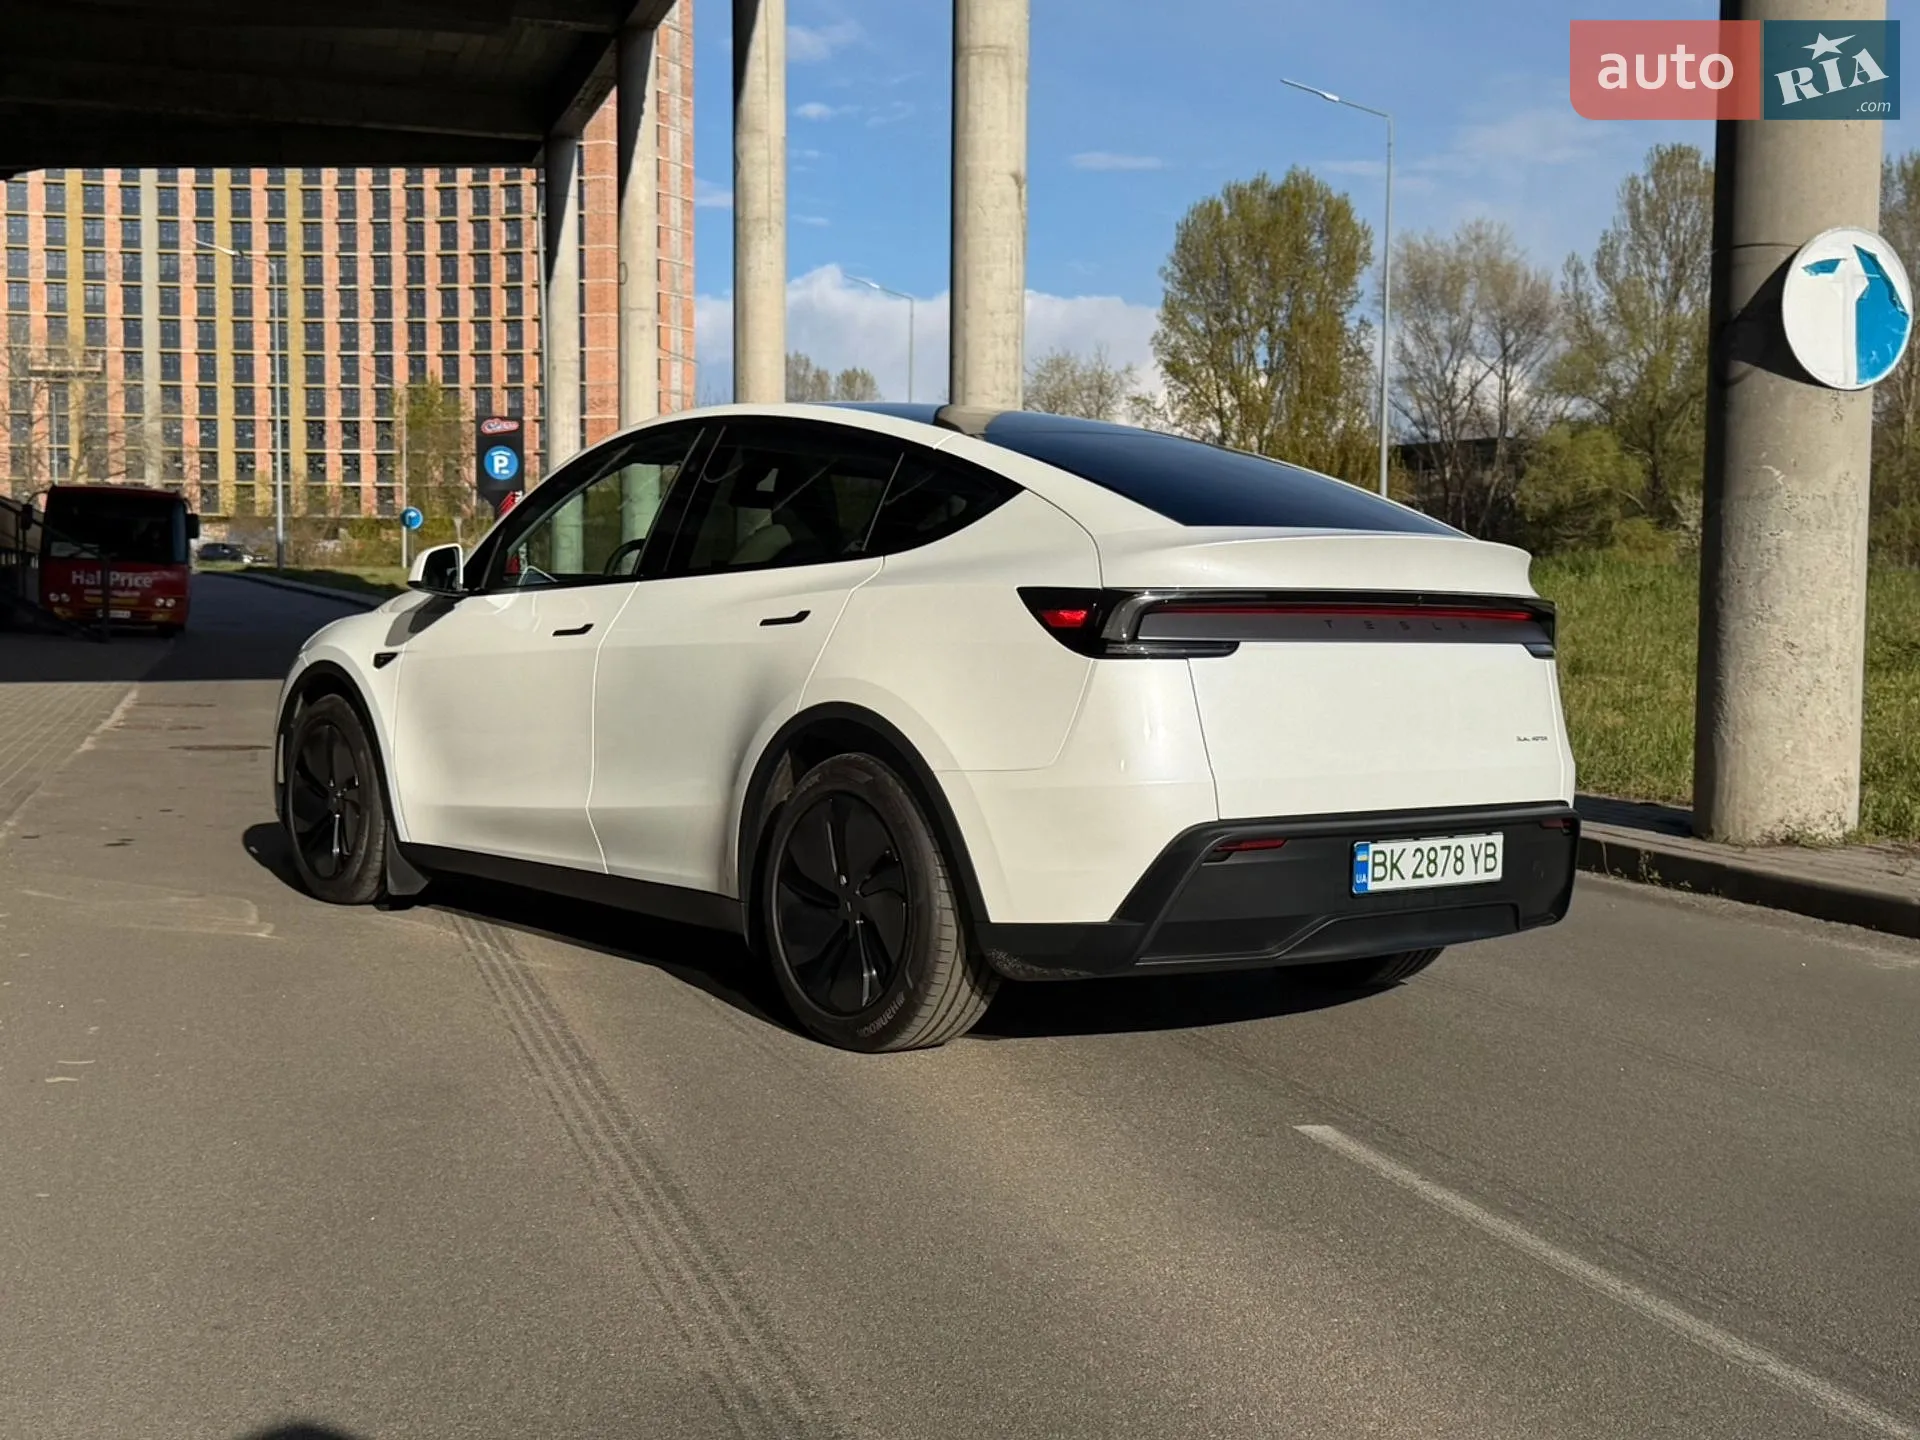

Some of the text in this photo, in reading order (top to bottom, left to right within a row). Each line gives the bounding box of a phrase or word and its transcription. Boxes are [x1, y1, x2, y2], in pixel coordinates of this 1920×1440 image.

[72, 571, 153, 588] Hal Price
[1324, 620, 1471, 631] TESLA
[1372, 842, 1498, 882] BK 2878 YB
[1356, 874, 1367, 883] UA
